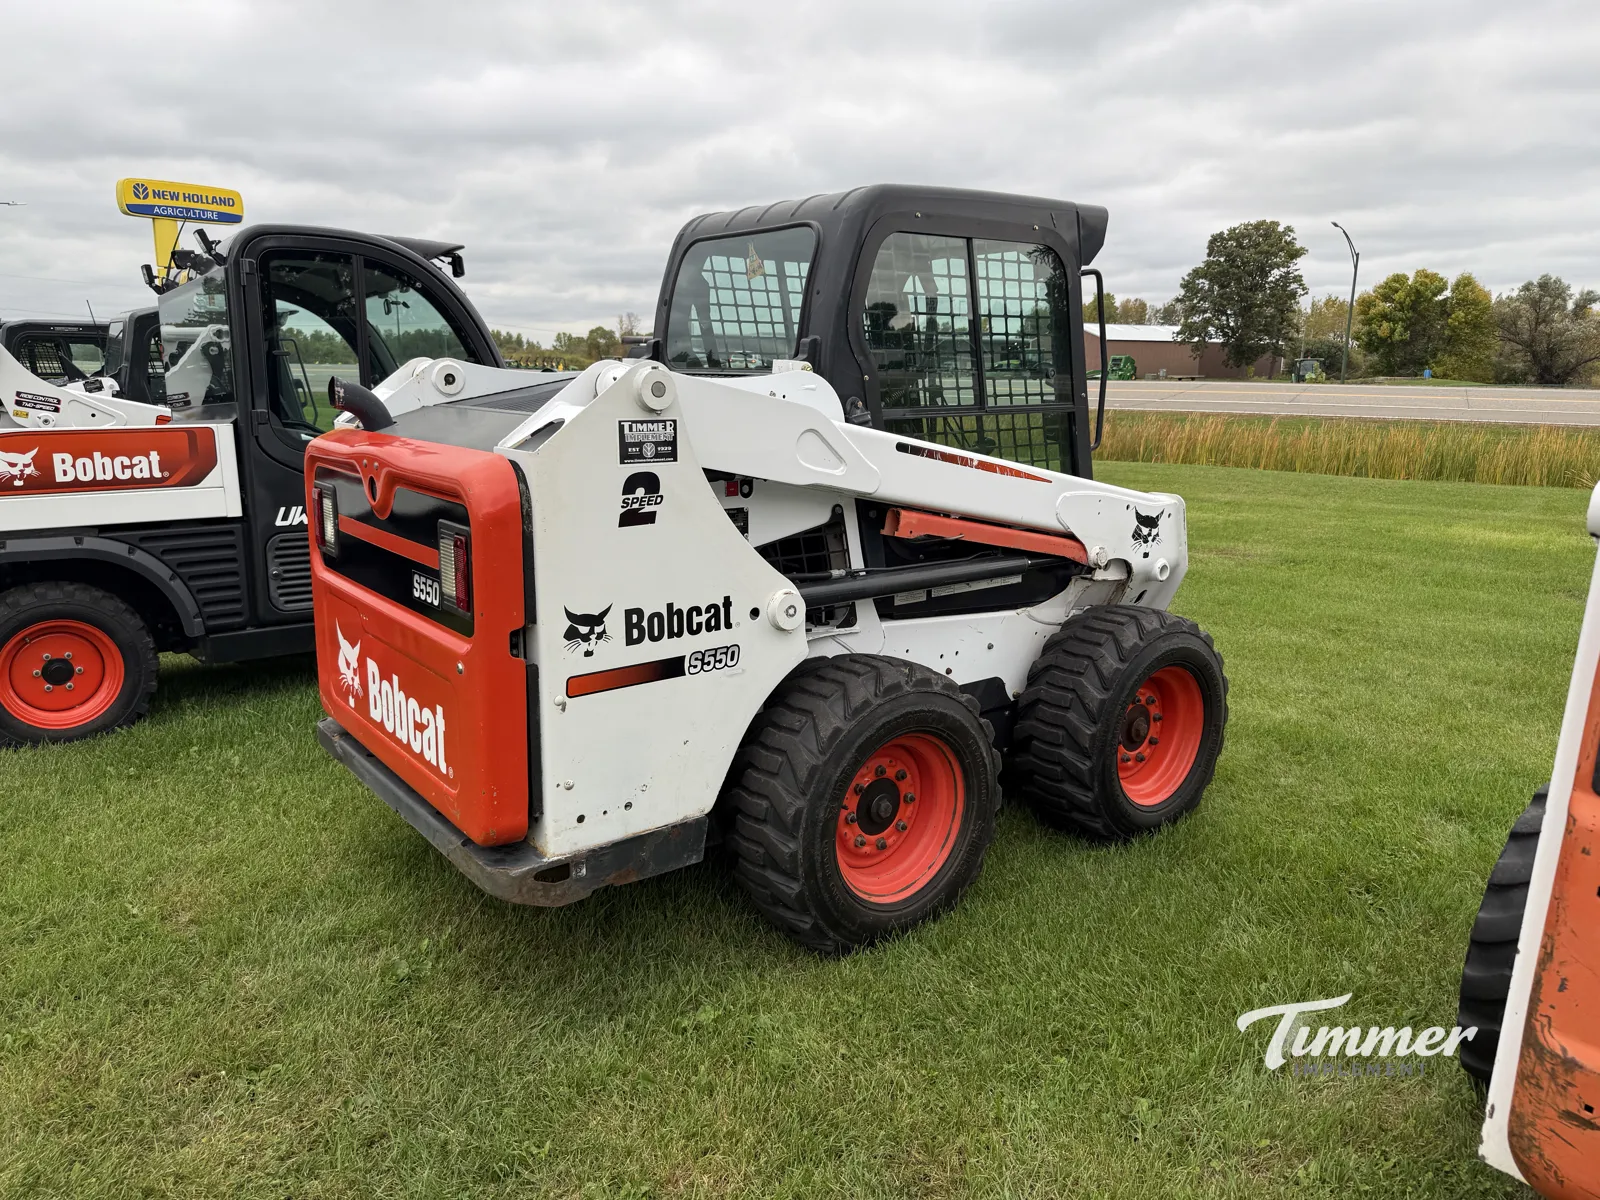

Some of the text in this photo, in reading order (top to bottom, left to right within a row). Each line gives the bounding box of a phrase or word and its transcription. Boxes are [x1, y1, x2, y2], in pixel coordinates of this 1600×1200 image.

[152, 189, 235, 207] NEW HOLLAND
[153, 206, 218, 219] AGRICULTURE
[33, 395, 59, 404] CONTROL
[620, 421, 674, 433] TIMMER
[625, 433, 674, 442] IMPLEMENT
[52, 450, 163, 483] Bobcat
[618, 471, 660, 527] 2
[620, 494, 664, 509] SPEED
[412, 573, 440, 606] S550
[624, 595, 733, 647] Bobcat
[688, 643, 741, 676] S550
[366, 656, 447, 775] Bobcat
